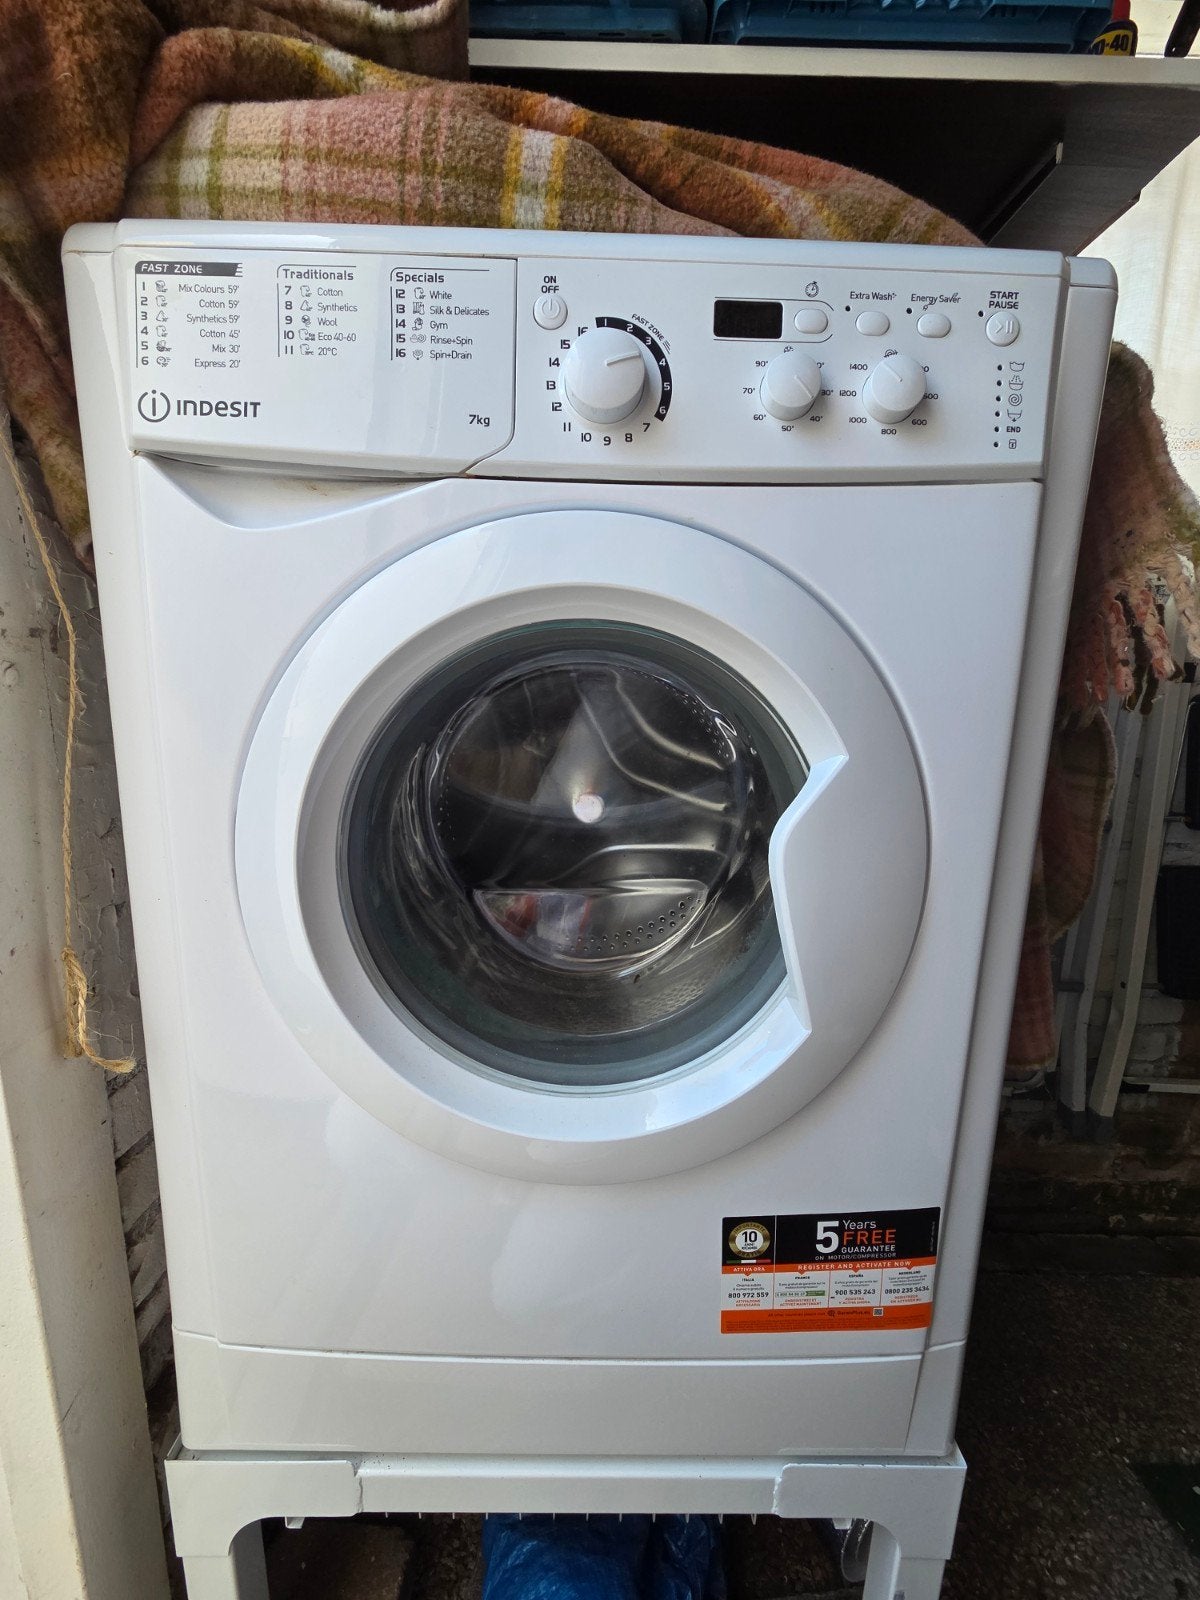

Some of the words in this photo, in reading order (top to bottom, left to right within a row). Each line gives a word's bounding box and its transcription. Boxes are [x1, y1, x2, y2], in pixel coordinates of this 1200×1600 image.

[141, 263, 169, 273] FAST
[174, 264, 202, 274] ZONE
[283, 269, 354, 280] Traditionals
[396, 272, 444, 284] Specials
[543, 276, 557, 284] ON
[142, 281, 146, 292] 1
[178, 284, 193, 293] Mix
[194, 285, 225, 294] Colours
[284, 286, 292, 295] 7
[317, 287, 343, 297] Cotton
[541, 286, 560, 294] OFF
[395, 289, 406, 298] 12
[430, 291, 452, 300] White
[850, 291, 870, 300] Extra
[872, 292, 892, 301] Wash
[911, 294, 938, 304] Energy
[939, 294, 962, 304] Saver
[990, 291, 1019, 300] START
[140, 297, 148, 306] 2
[199, 300, 225, 309] Cotton
[285, 301, 293, 310] 8
[317, 302, 358, 314] Synthetics
[988, 300, 1019, 310] PAUSE
[396, 304, 406, 314] 13
[430, 306, 444, 315] Silk
[445, 307, 452, 315] &
[454, 307, 490, 316] Delicates
[141, 312, 148, 321] 3
[187, 314, 228, 324] Synthetics
[285, 316, 293, 325] 9
[317, 317, 338, 326] Wool
[395, 319, 406, 329] 14
[430, 321, 448, 331] Gym
[627, 324, 634, 332] 2
[631, 313, 649, 327] FAST
[648, 324, 665, 342] ZONE
[141, 327, 149, 336] 4
[200, 330, 226, 338] Cotton
[284, 330, 294, 340] 10
[318, 332, 332, 341] Eco
[333, 332, 357, 342] 40-60
[396, 334, 406, 343] 15
[430, 336, 473, 346] Rinse+Spin
[561, 339, 571, 349] 15
[645, 336, 652, 345] 3
[141, 341, 149, 350] 5
[212, 344, 226, 354] Mix
[285, 345, 294, 354] 11
[318, 347, 338, 356] 20°C
[395, 348, 406, 358] 16
[430, 350, 472, 361] Spin+Drain
[141, 357, 149, 366] 6
[194, 359, 226, 369] Express
[549, 358, 560, 368] 14
[660, 358, 666, 366] 4
[755, 360, 768, 368] 90°
[546, 381, 556, 390] 13
[664, 382, 670, 390] 5
[176, 399, 261, 418] INDESIT
[552, 402, 562, 412] 12
[660, 406, 666, 414] 6
[468, 414, 490, 428] 7kg
[564, 422, 572, 432] 11
[643, 422, 651, 432] 7
[1006, 426, 1021, 434] END
[581, 433, 592, 442] 10
[604, 436, 611, 446] 9
[625, 433, 633, 442] 8
[742, 1231, 758, 1243] 10
[816, 1220, 840, 1254] 5
[842, 1220, 877, 1230] Years
[843, 1229, 896, 1246] FREE
[841, 1245, 896, 1254] GUARANTEE
